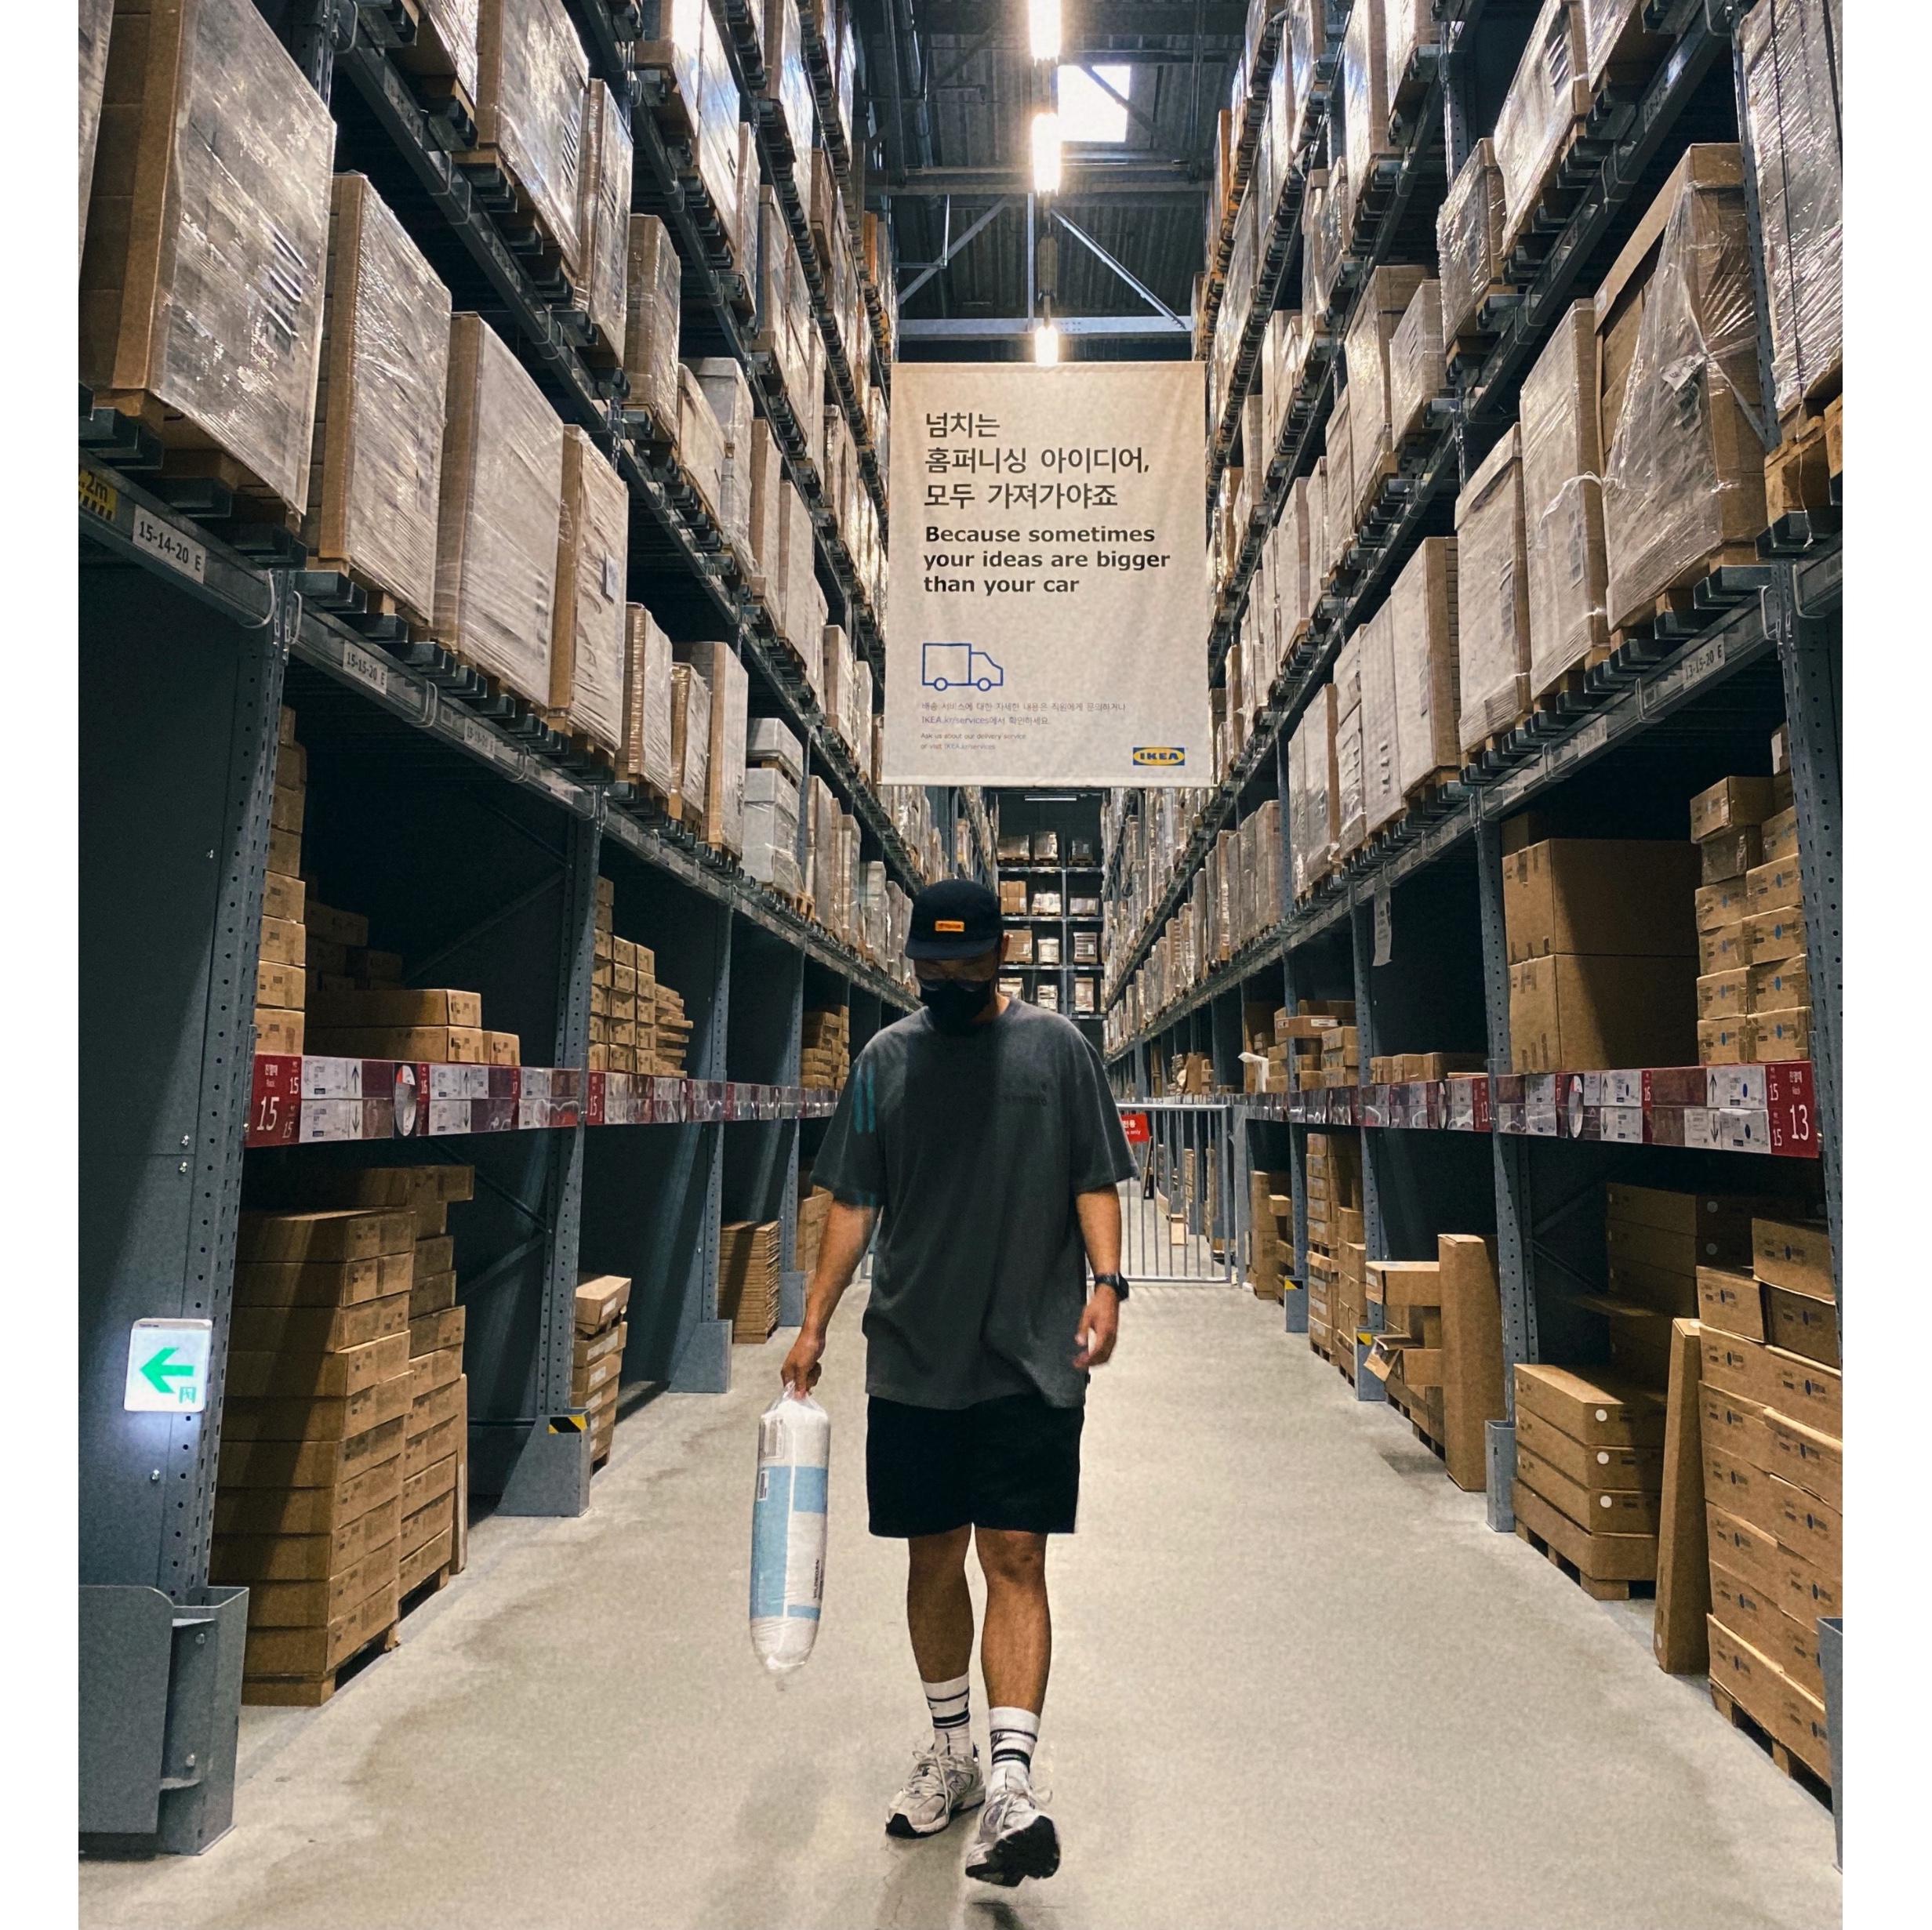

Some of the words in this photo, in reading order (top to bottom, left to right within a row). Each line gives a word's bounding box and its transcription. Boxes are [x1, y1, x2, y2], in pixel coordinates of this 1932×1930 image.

[926, 412, 1000, 438] 넘치는
[925, 447, 1026, 473] 홈퍼니싱
[1040, 447, 1149, 473] 아이디어,
[78, 470, 108, 502] .2m
[924, 484, 975, 509] 모두
[988, 483, 1118, 509] 가져가야죠
[926, 526, 1021, 542] Because
[1028, 525, 1156, 542] sometimes
[139, 521, 189, 564] 15-14-20
[194, 554, 202, 572] E
[924, 553, 975, 571] your
[982, 550, 1043, 567] ideas
[1051, 553, 1088, 567] are
[1097, 550, 1171, 571] bigger
[924, 575, 975, 593] than
[984, 579, 1036, 596] your
[1043, 579, 1080, 593] car
[347, 651, 378, 680] 15-15-20
[380, 671, 385, 686] E
[1686, 649, 1714, 680] 13-15-20
[1717, 644, 1722, 658] E
[922, 702, 937, 711] 배송
[942, 702, 973, 711] 서비스에
[977, 702, 992, 711] 대한
[997, 702, 1019, 711] 자세한
[1023, 702, 1048, 712] 내용은
[1051, 702, 1083, 712] 직원에게
[1088, 702, 1126, 712] 문의하거나
[289, 1076, 300, 1094] 15
[1769, 1083, 1779, 1101] 15
[256, 1096, 280, 1131] 15
[590, 1095, 597, 1116] 15
[281, 1120, 294, 1139] 15
[1789, 1103, 1810, 1141] 13
[1773, 1128, 1782, 1147] 15
